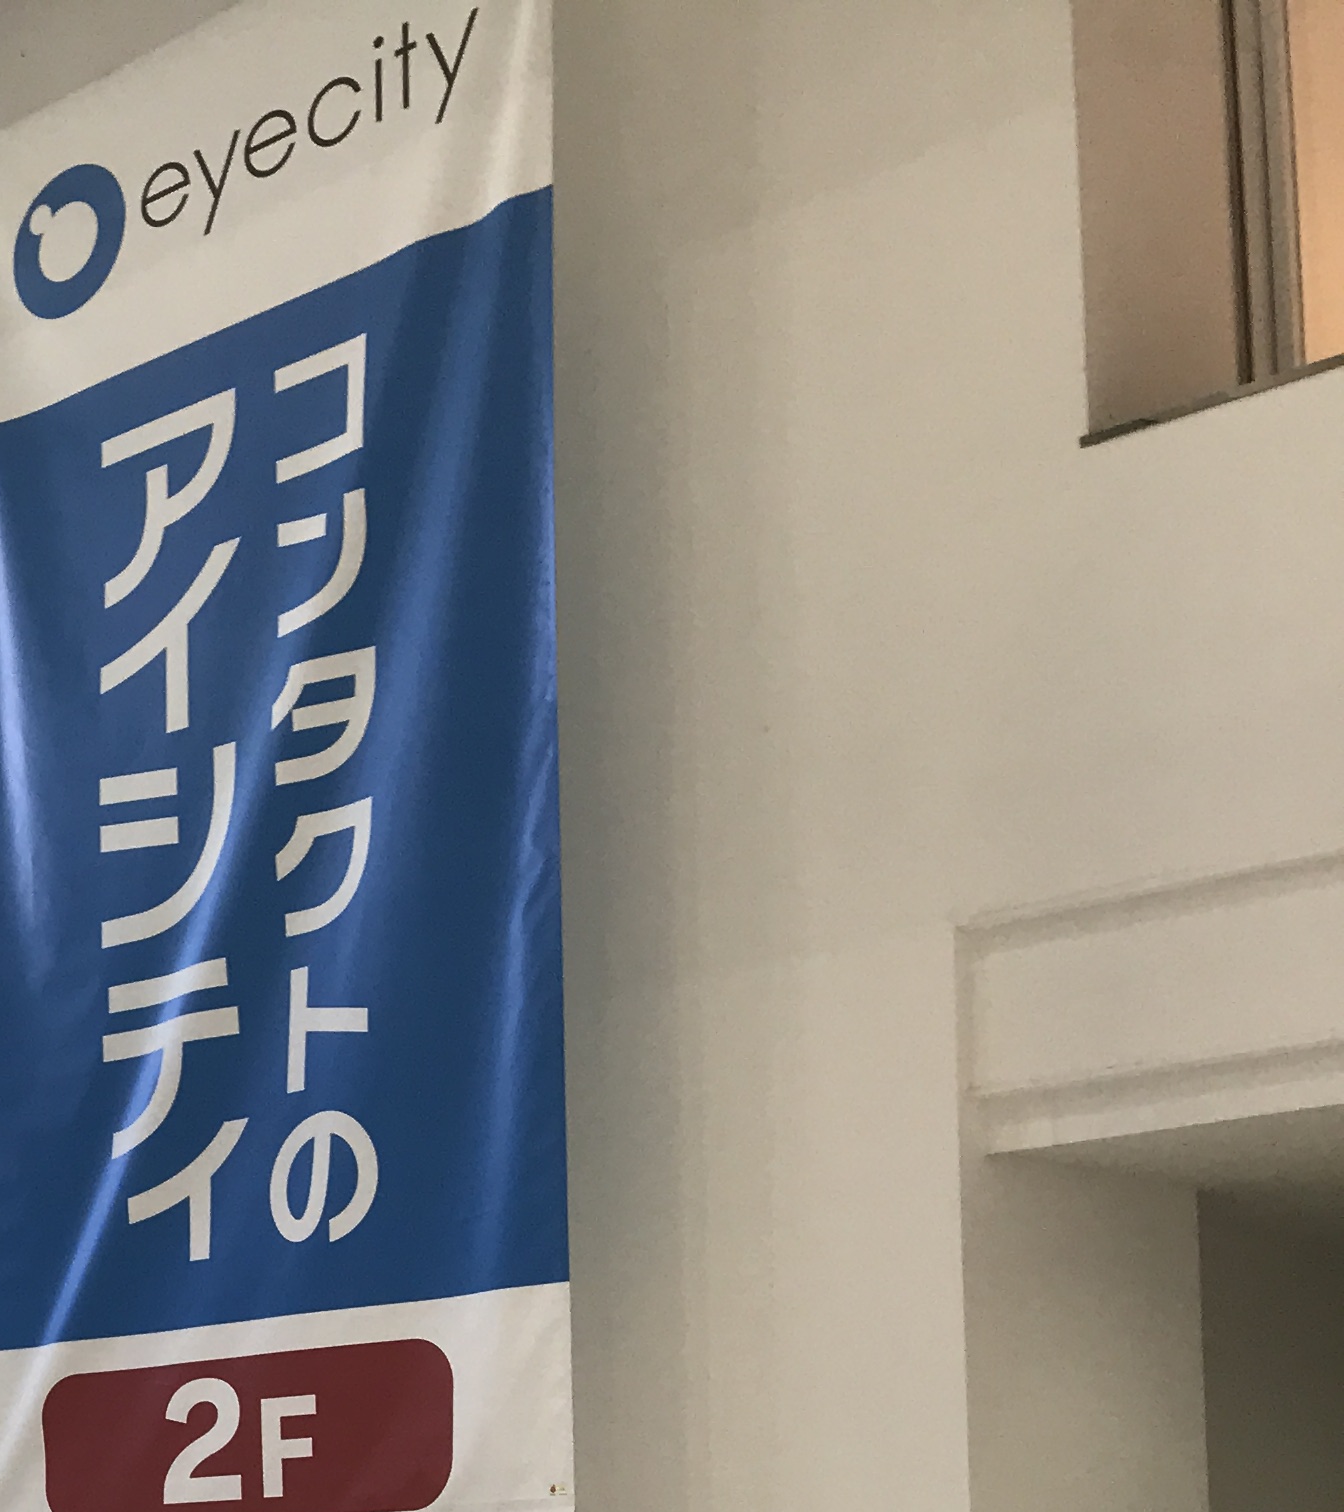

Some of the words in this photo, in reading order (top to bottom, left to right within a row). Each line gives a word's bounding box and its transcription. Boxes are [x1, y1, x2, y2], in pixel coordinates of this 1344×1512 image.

[141, 8, 479, 236] eyecity
[99, 388, 250, 1262] アイシティ
[269, 333, 379, 1243] コンタクトの
[163, 1377, 317, 1505] 2F
